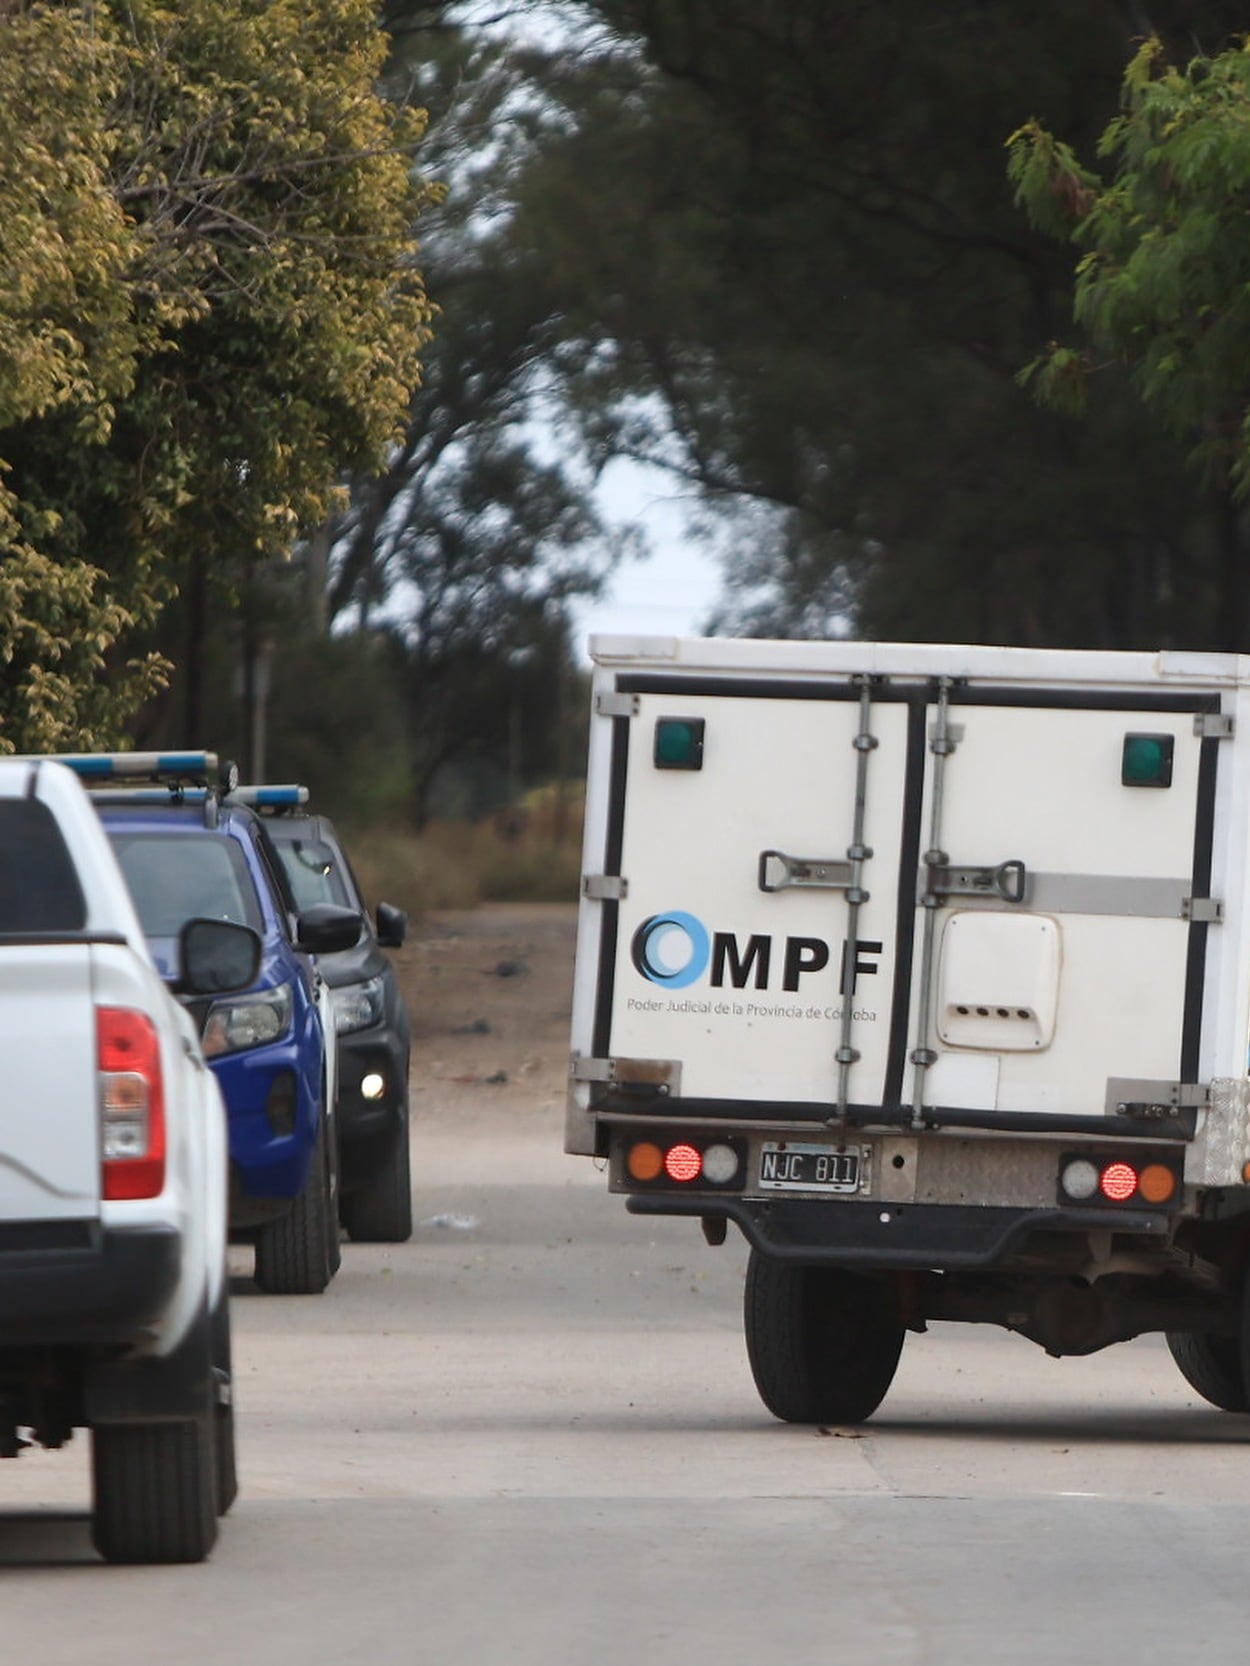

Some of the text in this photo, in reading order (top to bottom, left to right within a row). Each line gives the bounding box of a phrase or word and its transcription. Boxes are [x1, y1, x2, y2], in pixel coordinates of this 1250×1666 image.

[710, 931, 883, 996] MPF
[627, 998, 876, 1022] Poder Judicial de la Provincia de Cóoba
[763, 1154, 854, 1183] NJC 811
